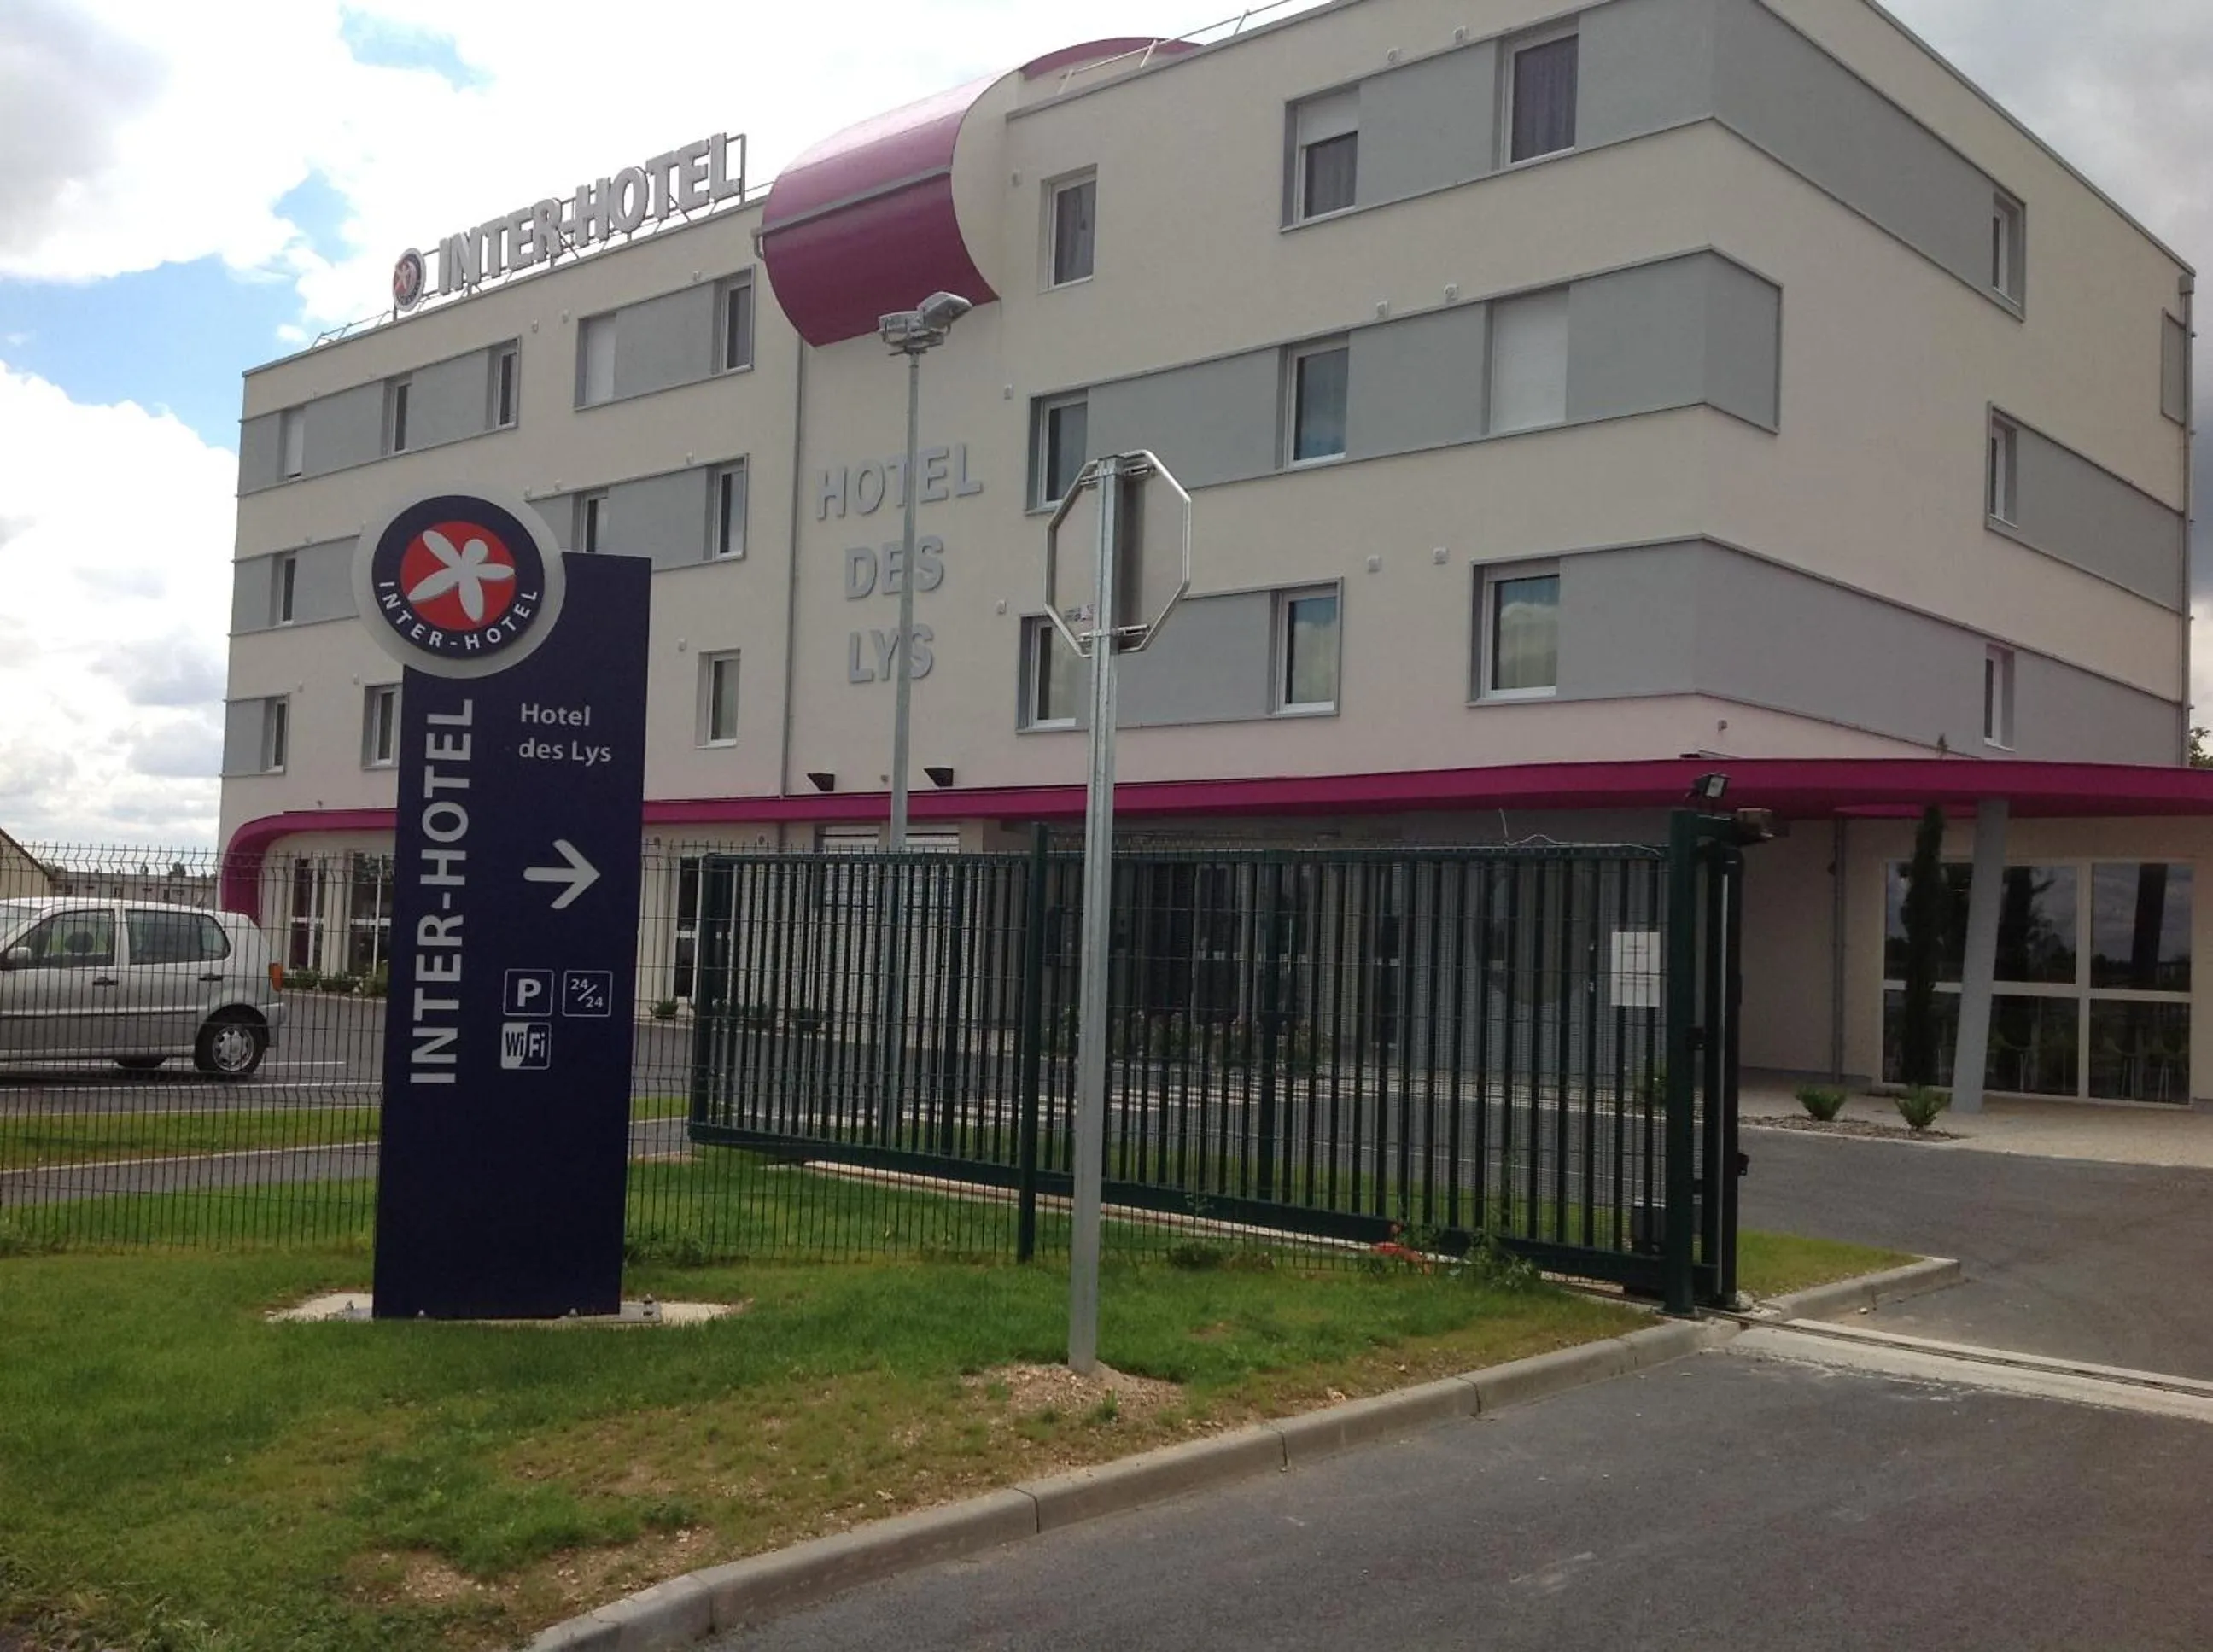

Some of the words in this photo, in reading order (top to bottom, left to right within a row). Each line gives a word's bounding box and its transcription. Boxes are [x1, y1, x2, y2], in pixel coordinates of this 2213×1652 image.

[437, 132, 741, 295] INTER-HOTEL
[815, 442, 983, 521] HOTEL
[844, 536, 945, 600] DES
[379, 581, 538, 650] INTER-HOTEL
[848, 622, 934, 684] LYS
[520, 703, 591, 726] Hotel
[518, 738, 564, 760] des
[571, 740, 612, 767] Lys
[410, 698, 473, 1083] INTER-HOTEL
[517, 978, 541, 1007] P
